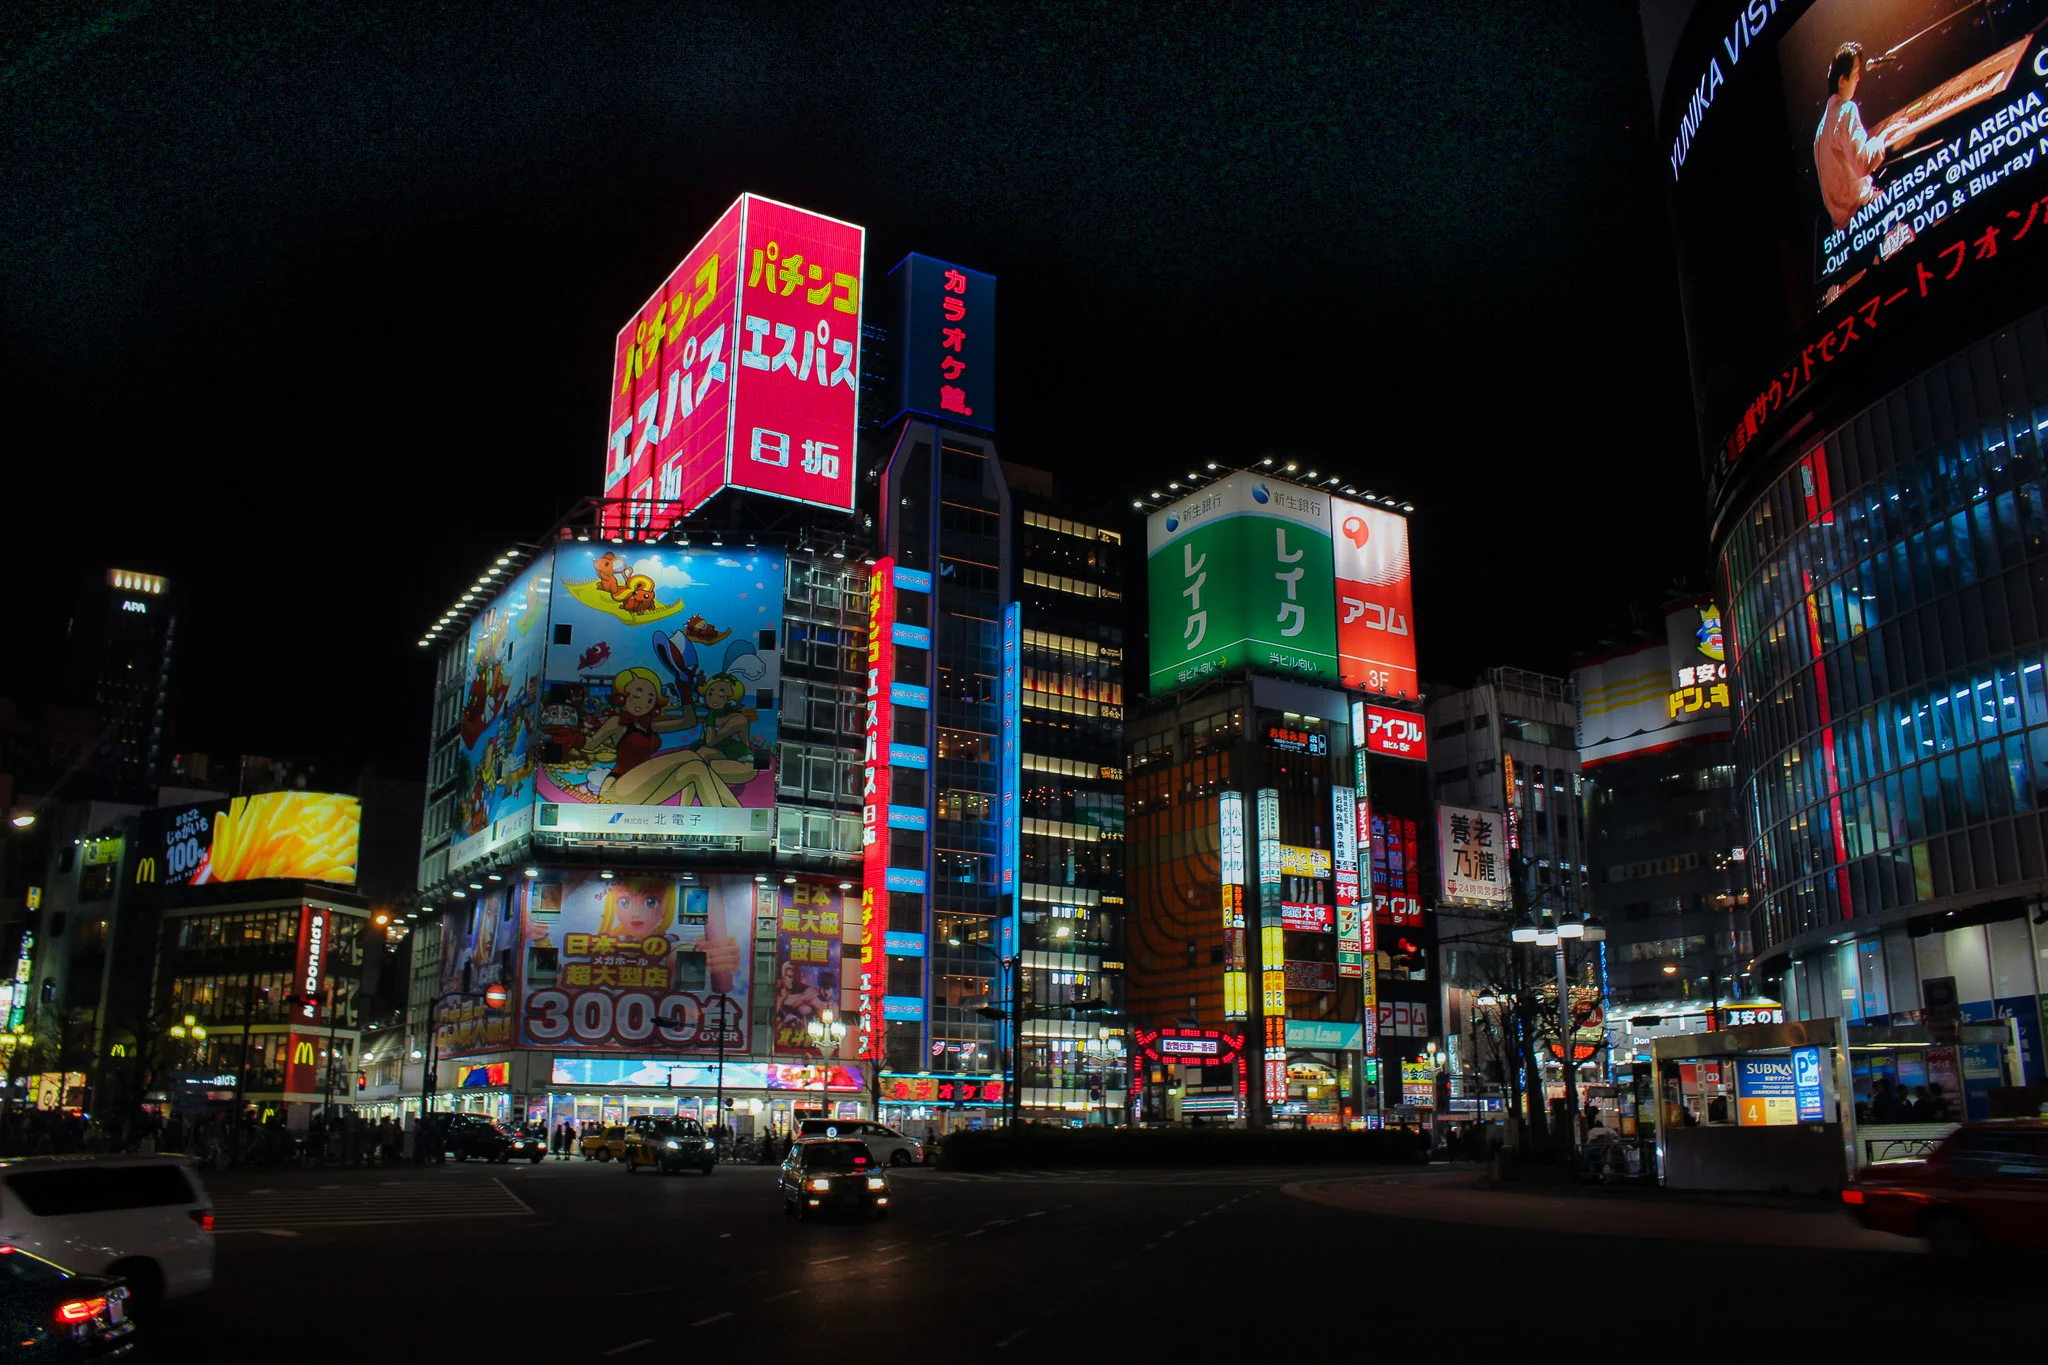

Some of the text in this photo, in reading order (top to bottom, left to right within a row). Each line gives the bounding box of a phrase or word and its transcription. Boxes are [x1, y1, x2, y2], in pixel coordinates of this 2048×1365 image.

[1669, 57, 1725, 183] YUNIKA
[1823, 90, 2043, 254] 5th ANNIVERSARY ARENA
[1879, 222, 1912, 259] LIVE
[1912, 200, 1949, 237] DVD
[1952, 189, 1967, 208] &
[1968, 147, 2036, 198] Blu-ray
[1852, 214, 1894, 251] Glory
[747, 240, 859, 315] パチンコ
[622, 253, 720, 395] パチンコ
[741, 314, 857, 393] エスパス
[608, 323, 727, 489] エスパス
[750, 426, 840, 480] 日拓
[1182, 492, 1223, 523] 新生銀行
[1273, 491, 1321, 517] 新生銀行
[1183, 542, 1208, 651] レイク
[1276, 527, 1306, 637] レイク
[122, 601, 147, 613] APA
[868, 570, 884, 663] パチンコ
[1341, 596, 1409, 637] アコム
[1269, 652, 1317, 672] 当ビル向い
[1368, 669, 1390, 688] 3F
[864, 667, 880, 798] エスパス
[1367, 713, 1423, 743] アイフル
[166, 816, 209, 845] じゃがいも
[654, 812, 703, 827] 北電子
[1450, 812, 1493, 848] 養老
[1232, 807, 1243, 872] 小松ビル
[166, 836, 209, 877] 100%
[1452, 848, 1497, 883] 乃瀧
[793, 884, 832, 906] 日本
[1374, 894, 1421, 916] アイフル
[781, 908, 840, 936] 最大級
[566, 934, 670, 956] 日本一の
[789, 938, 831, 962] 設置
[1339, 941, 1360, 952] たばこ
[593, 956, 650, 966] メガホール
[858, 886, 875, 1055] パチンコ エスパス
[565, 964, 670, 989] 超大型店
[529, 990, 700, 1043] 3000
[1379, 1006, 1426, 1026] アコム
[699, 1031, 739, 1043] OVER
[931, 1041, 976, 1058] ダーツ
[1633, 1036, 1650, 1045] Don
[1796, 1056, 1809, 1083] P
[1747, 1104, 1759, 1122] 4
